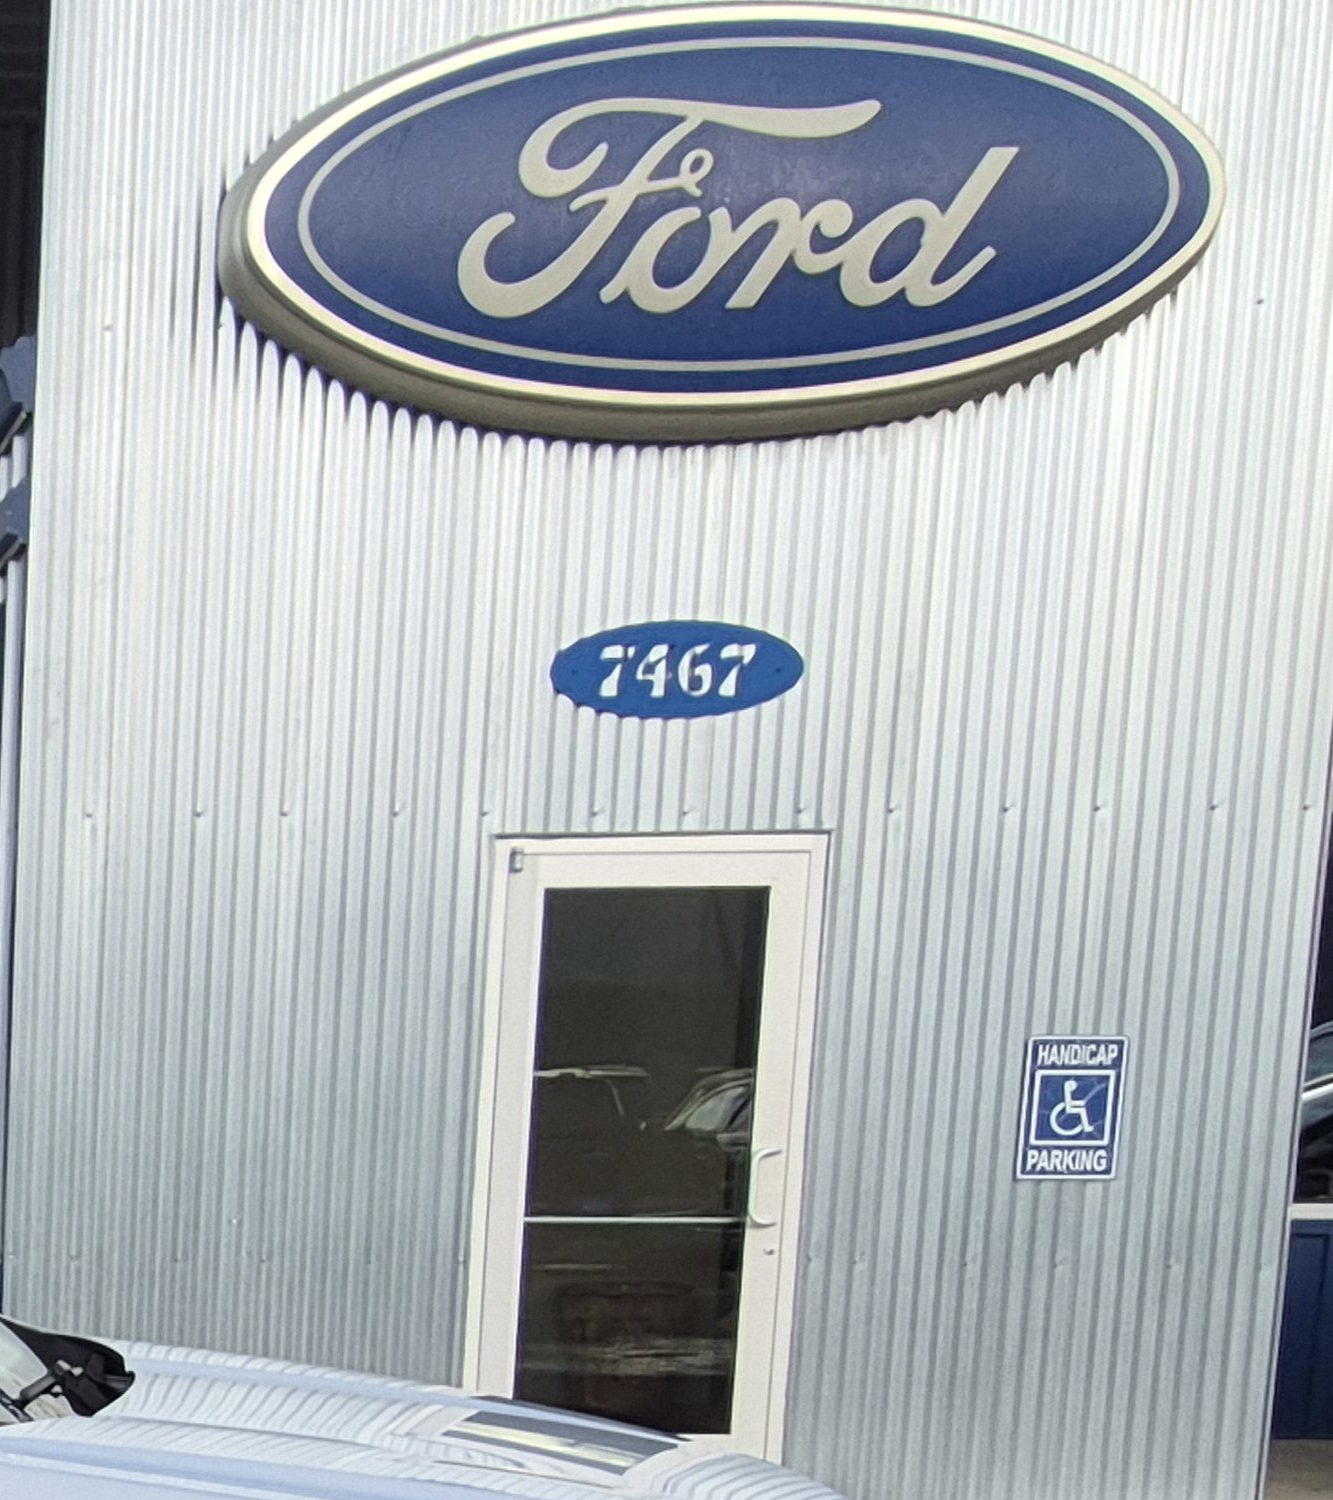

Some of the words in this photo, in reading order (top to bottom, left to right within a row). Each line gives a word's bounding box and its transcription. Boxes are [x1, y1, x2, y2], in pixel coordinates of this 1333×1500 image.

[457, 96, 1020, 318] Ford
[599, 642, 757, 698] 7467
[1037, 1043, 1119, 1067] HANDICAP
[1025, 1149, 1108, 1172] PARKING
